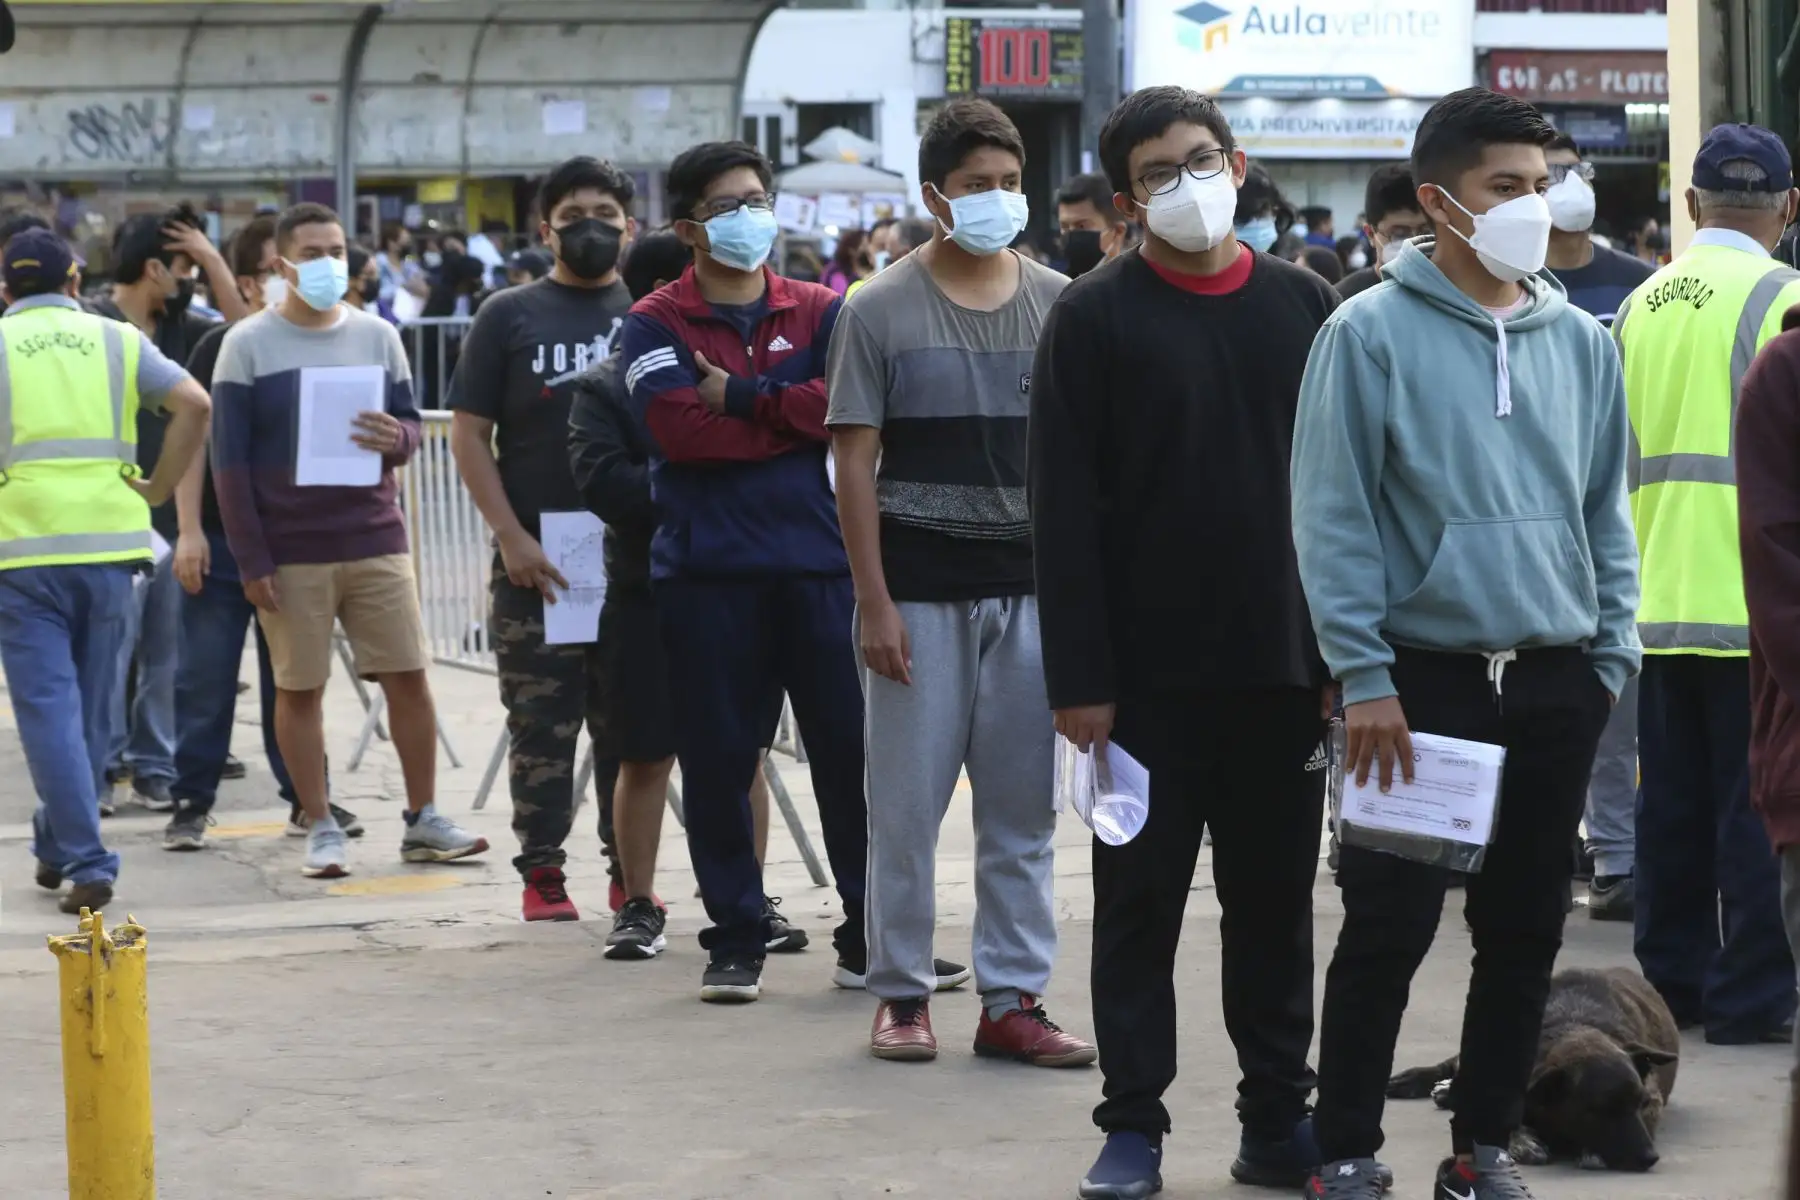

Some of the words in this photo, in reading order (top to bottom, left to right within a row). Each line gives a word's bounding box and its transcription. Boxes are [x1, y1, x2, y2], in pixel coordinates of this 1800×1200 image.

[1243, 5, 1440, 37] Aulaveinte
[981, 29, 1049, 87] 100
[1600, 68, 1669, 95] PLOTE
[1646, 277, 1713, 312] SEGURIDAD
